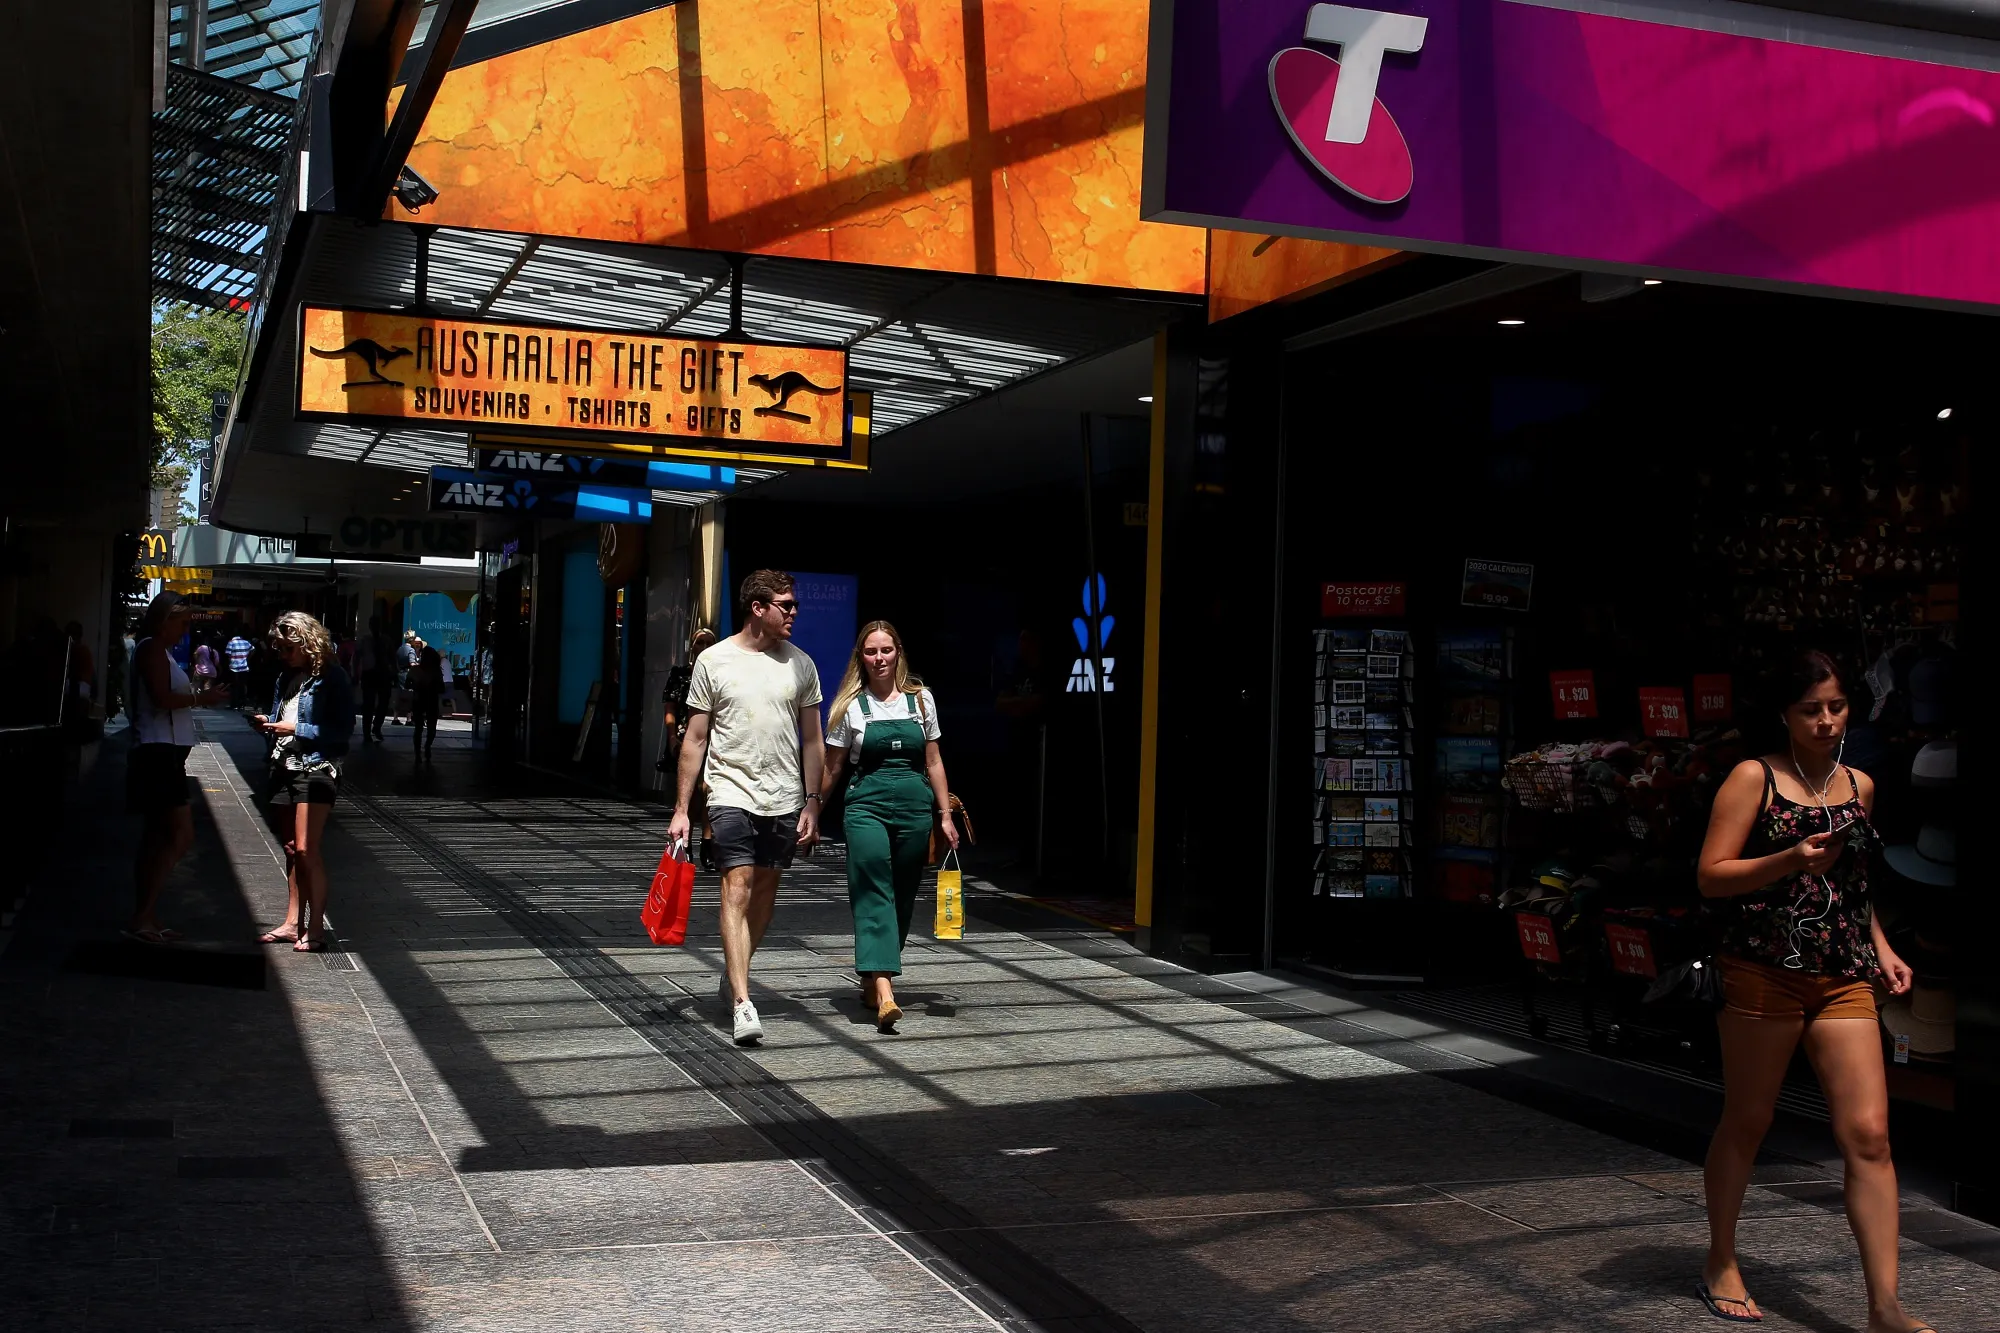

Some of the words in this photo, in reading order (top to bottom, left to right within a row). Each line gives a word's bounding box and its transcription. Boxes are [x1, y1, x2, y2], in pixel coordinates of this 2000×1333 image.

[416, 326, 593, 387] AUSTRALIA
[610, 341, 664, 392] THE
[680, 347, 745, 398] GIFT
[414, 386, 531, 420] SOUVENIRS
[567, 396, 651, 428] TSHIRTS
[687, 405, 742, 434] GIFTS
[490, 450, 564, 472] ANZ
[439, 481, 504, 507] ANZ
[340, 516, 469, 553] OPTUS
[1468, 562, 1487, 571] 2020
[1488, 563, 1530, 575] CALENDARS
[824, 584, 849, 593] TALK
[1325, 584, 1401, 595] Postcards
[1337, 596, 1350, 605] 10
[1355, 597, 1370, 605] for
[1374, 595, 1391, 606] $5
[418, 620, 461, 630] Everlasting
[1065, 657, 1115, 692] ANZ
[1559, 688, 1566, 702] 4
[1572, 687, 1589, 701] $20
[1701, 695, 1724, 710] $7.99
[1648, 704, 1655, 718] 2
[1661, 704, 1679, 719] $20
[945, 887, 953, 922] OPTUS
